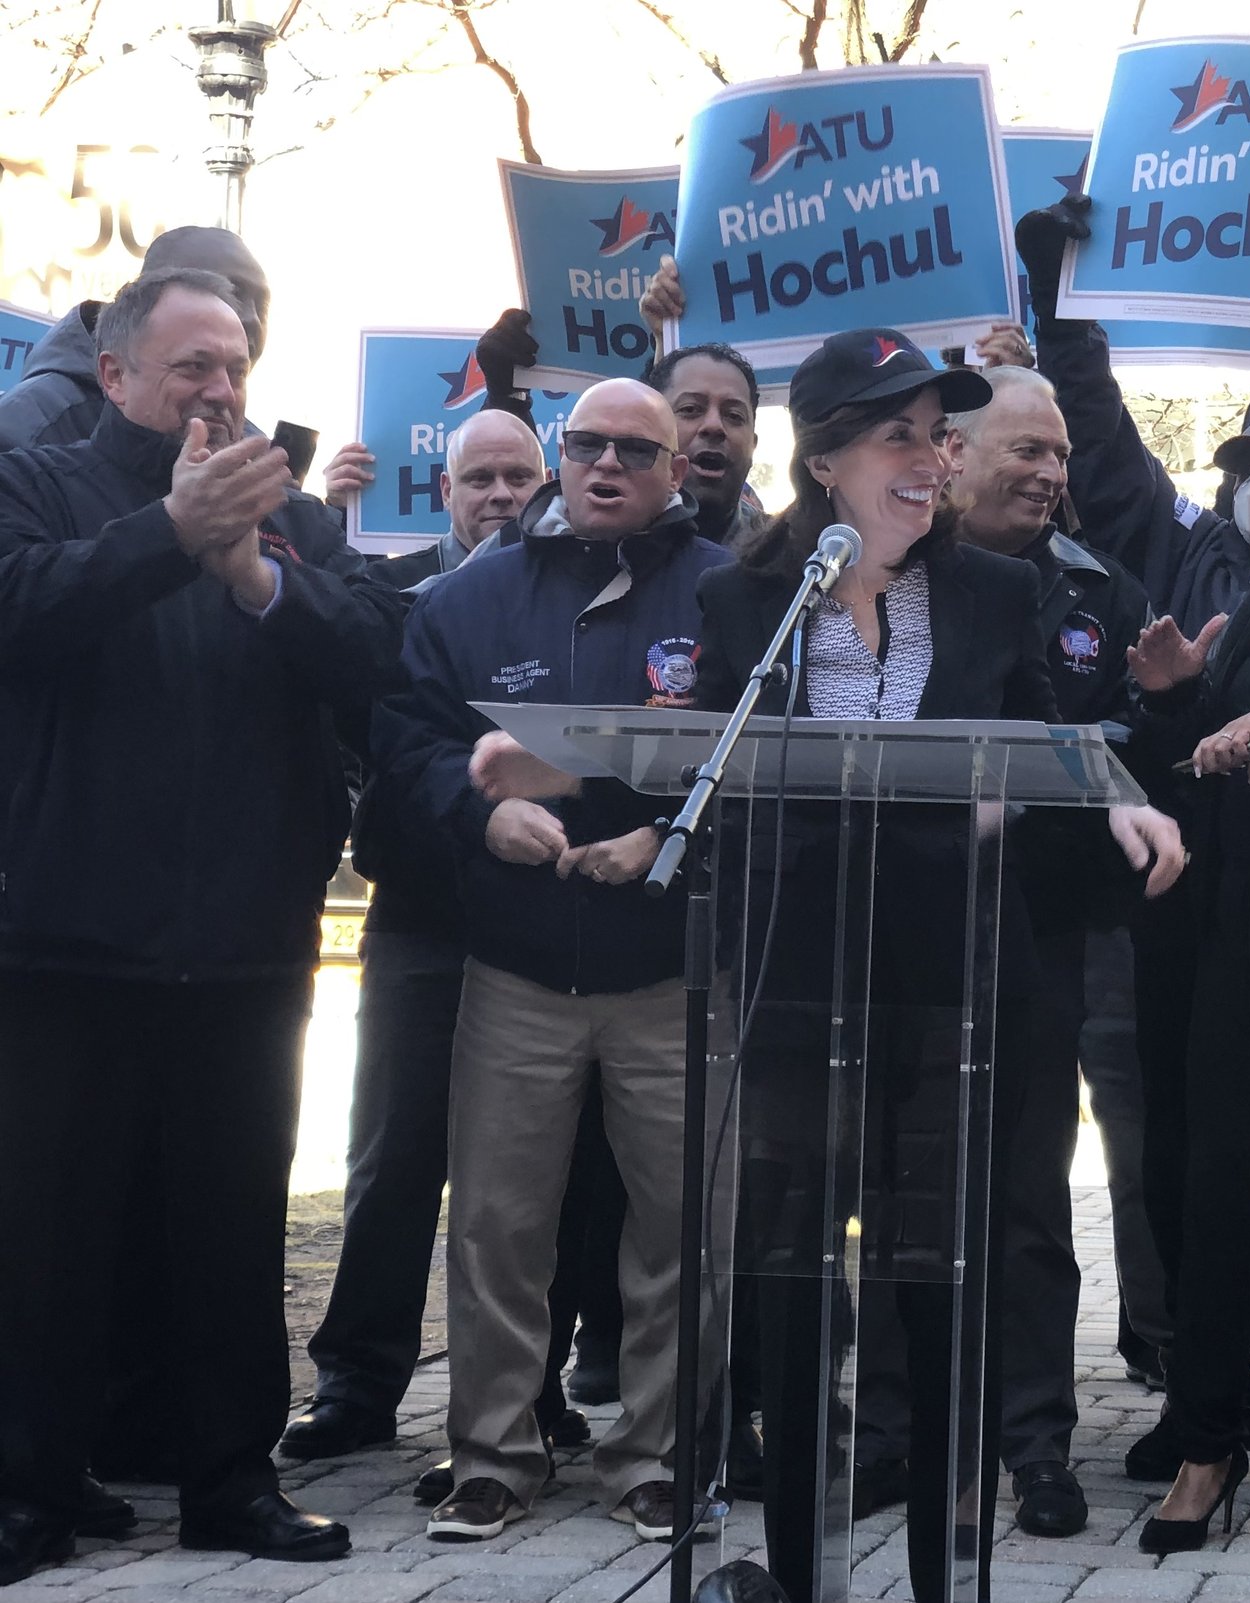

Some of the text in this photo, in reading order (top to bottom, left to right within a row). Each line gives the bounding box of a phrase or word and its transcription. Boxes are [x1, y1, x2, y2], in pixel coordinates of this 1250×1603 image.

[794, 105, 894, 169] ATU
[843, 158, 939, 213] with
[712, 204, 963, 323] Hochul
[525, 668, 551, 678] AGENT
